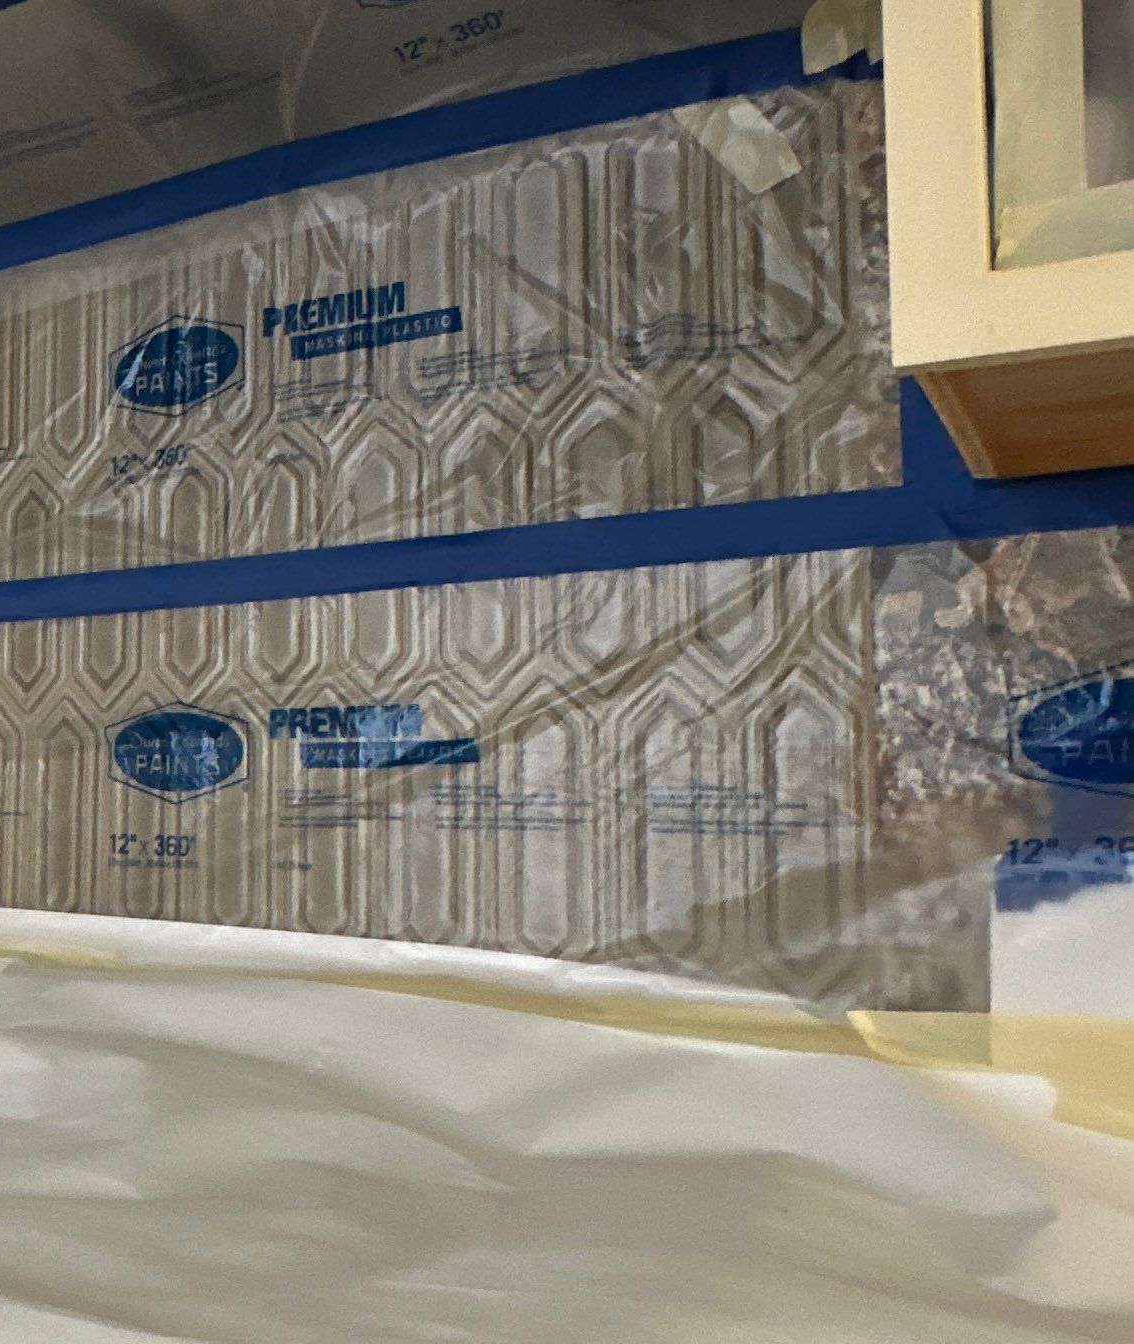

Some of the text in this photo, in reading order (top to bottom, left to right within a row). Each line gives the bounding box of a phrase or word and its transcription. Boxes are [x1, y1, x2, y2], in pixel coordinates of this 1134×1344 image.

[263, 281, 405, 336] PREMIUM
[110, 833, 138, 854] 12"
[1008, 837, 1060, 865] 12"
